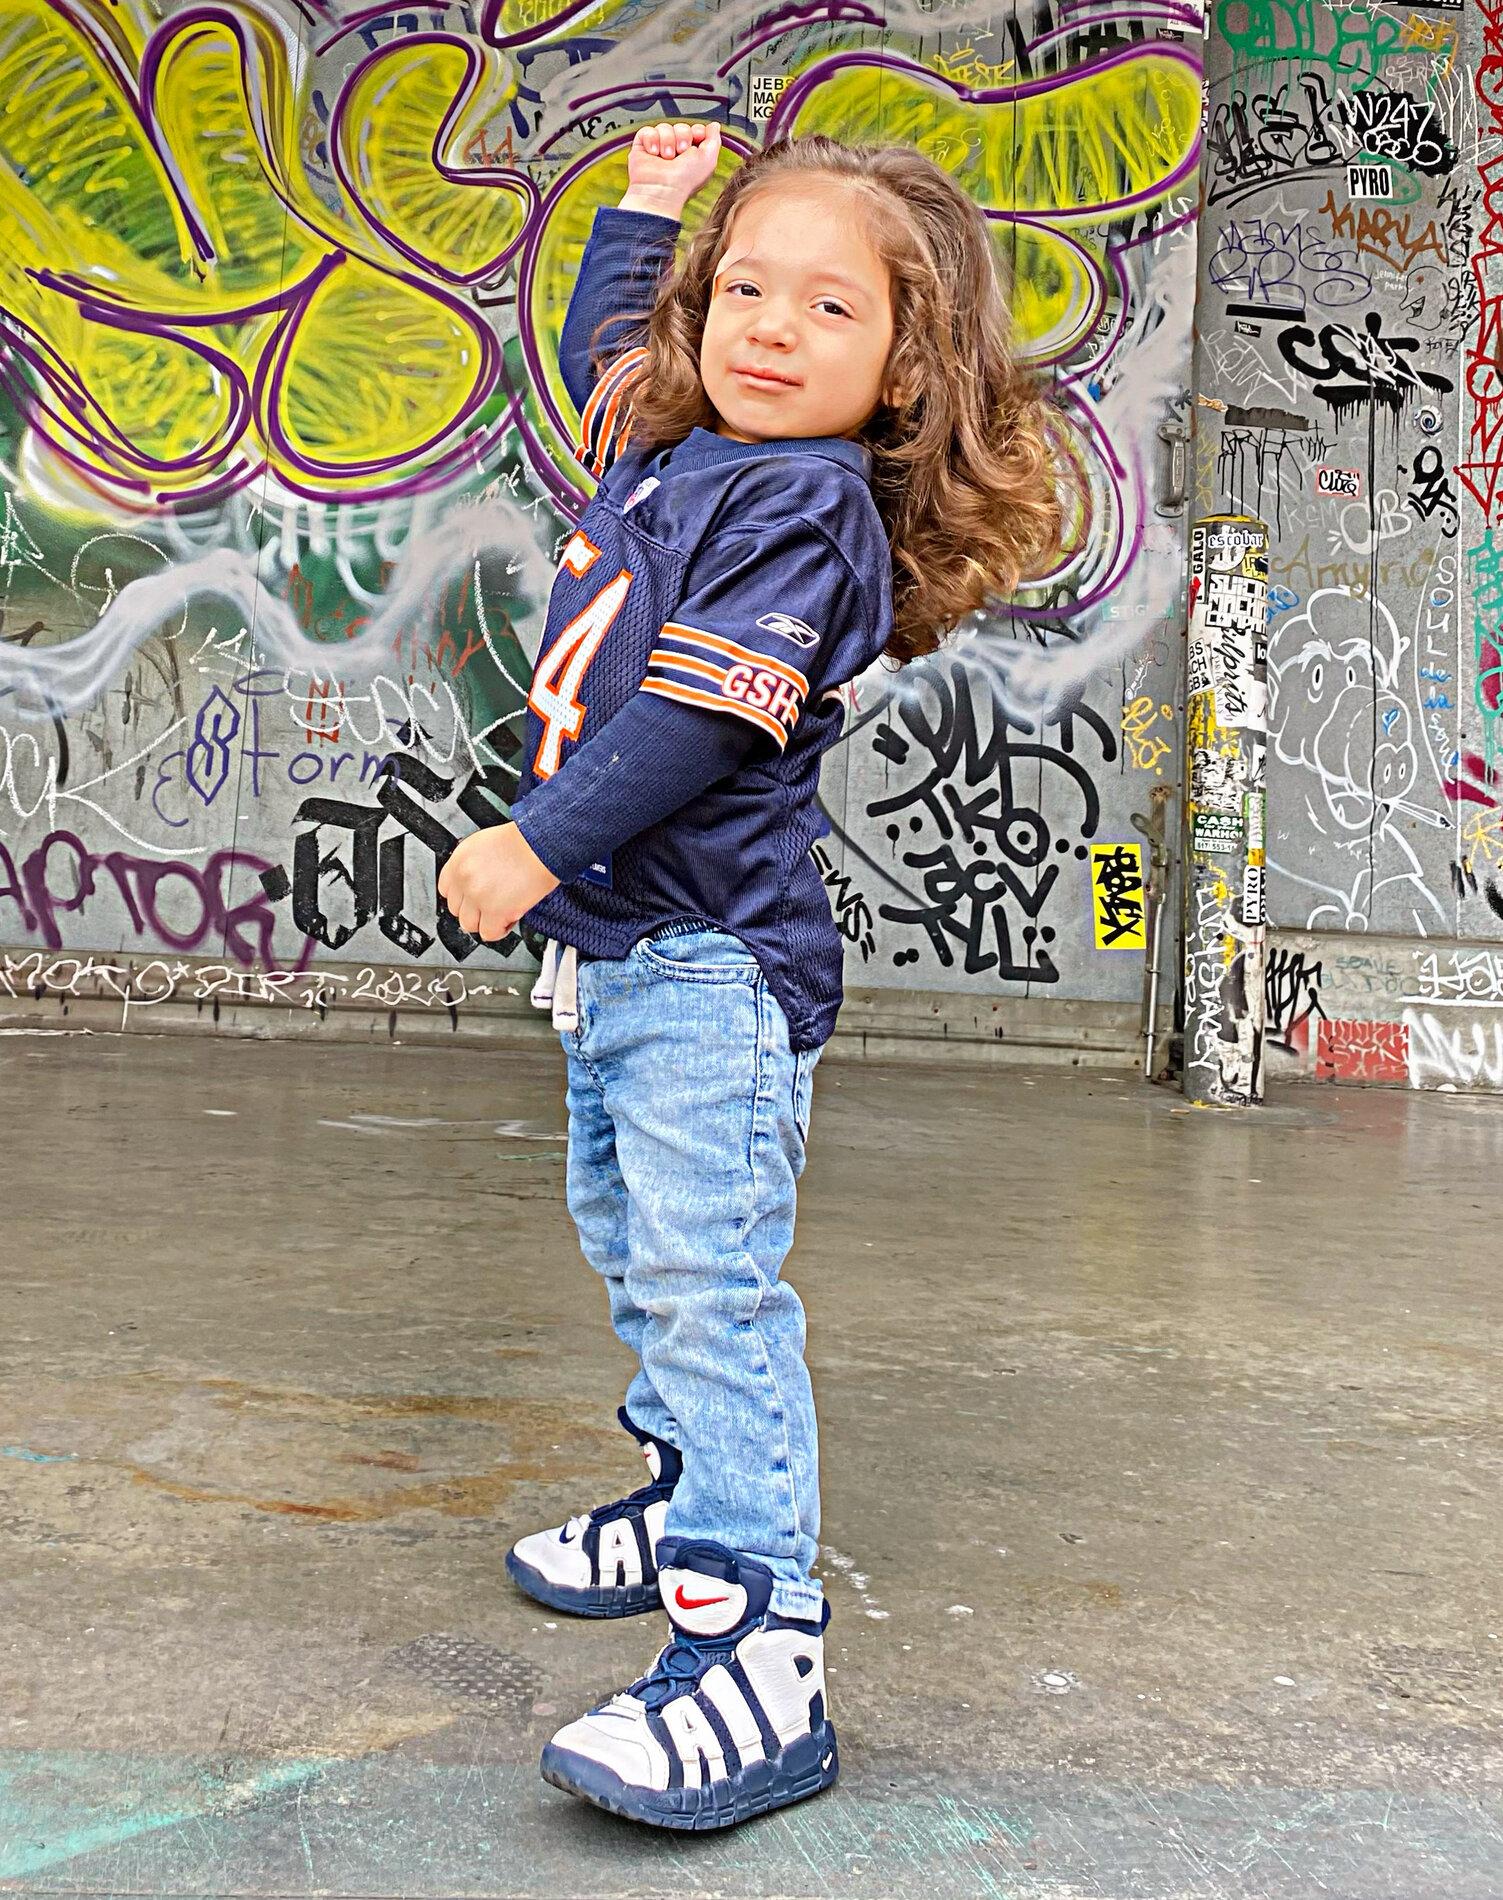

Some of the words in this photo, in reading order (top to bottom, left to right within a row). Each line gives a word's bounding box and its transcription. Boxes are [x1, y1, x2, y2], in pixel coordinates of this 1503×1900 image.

[1350, 168, 1390, 195] PYRO
[1193, 531, 1204, 574] GALO
[1209, 530, 1262, 547] escobar
[722, 664, 800, 722] GSH
[1197, 815, 1243, 827] CASH
[1246, 867, 1258, 921] PYRO
